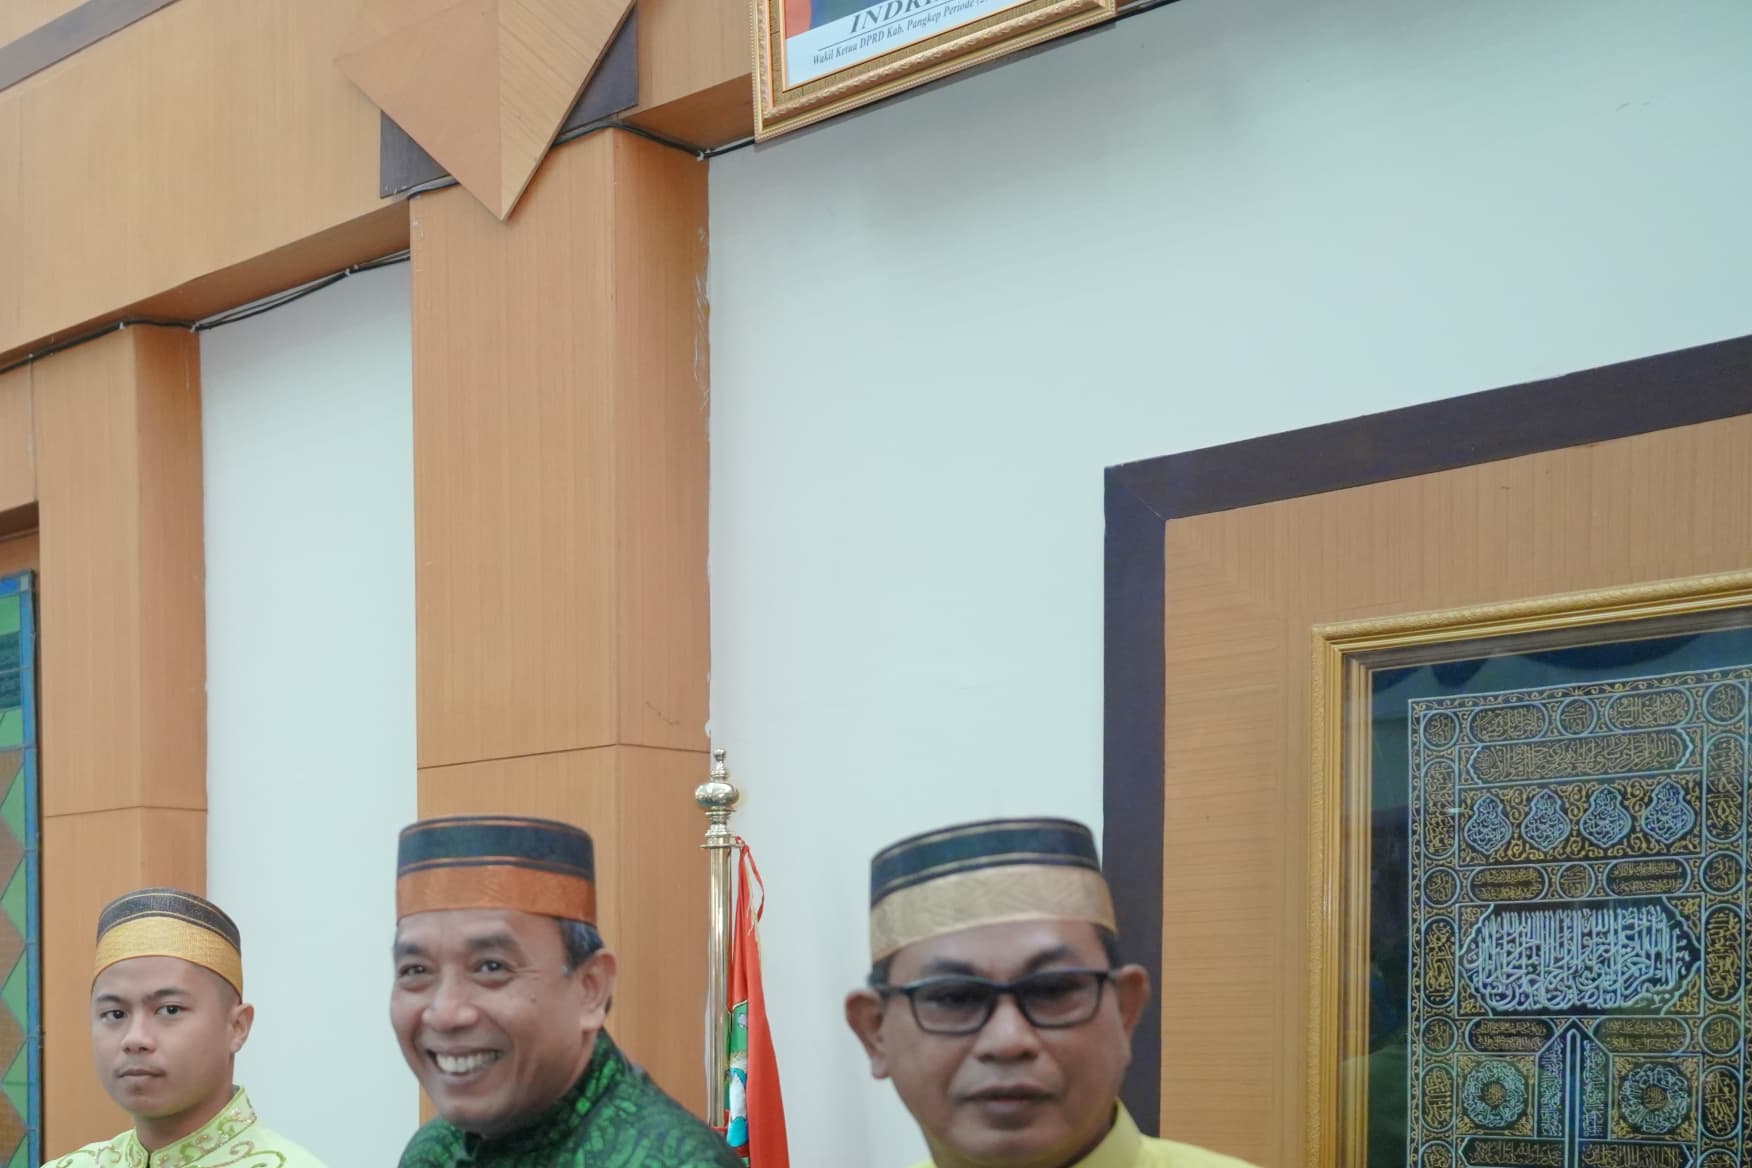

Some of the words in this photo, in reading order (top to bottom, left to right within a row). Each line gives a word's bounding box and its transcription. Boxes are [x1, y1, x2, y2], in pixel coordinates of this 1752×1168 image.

[813, 48, 834, 65] Wakil
[835, 43, 858, 58] Ketua
[860, 30, 885, 49] DPRD
[886, 25, 905, 38] Kab.
[907, 10, 942, 31] Pangkep
[850, 0, 939, 33] INDR
